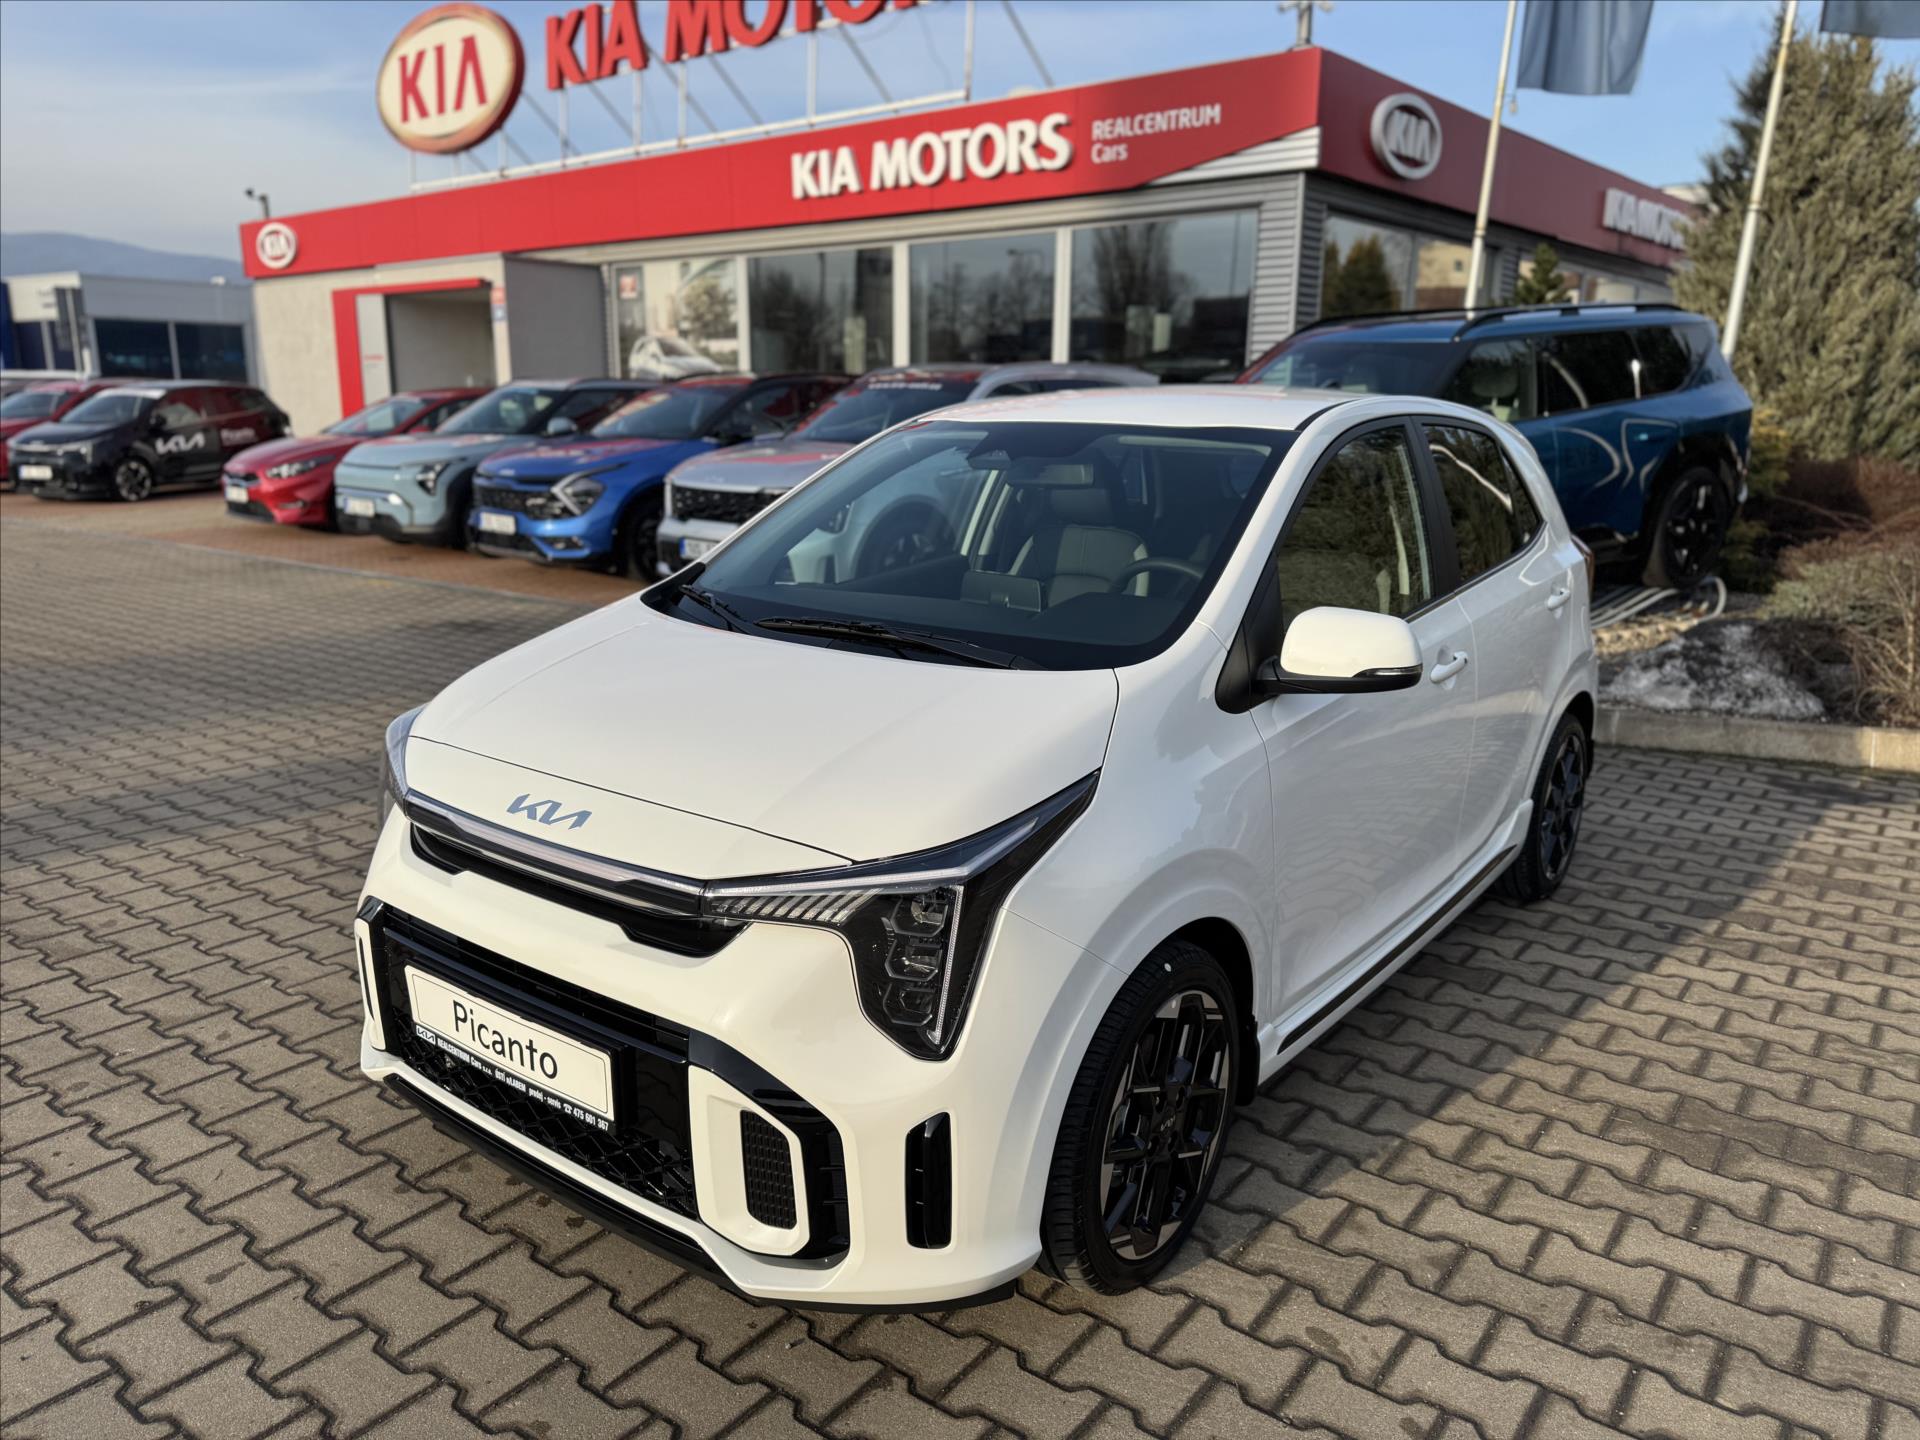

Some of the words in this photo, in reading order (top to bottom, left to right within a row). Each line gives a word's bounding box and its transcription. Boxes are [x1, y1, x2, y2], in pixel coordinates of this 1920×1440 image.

[398, 35, 488, 123] KIA
[545, 0, 649, 91] KIA
[1091, 103, 1222, 141] REALCENTRUM
[1091, 143, 1129, 165] Cars
[1386, 108, 1431, 163] KIA
[791, 146, 862, 200] KIA
[870, 113, 1073, 190] MOTORS
[155, 431, 205, 455] KIA
[506, 793, 592, 830] KIA
[453, 999, 558, 1080] Picanto
[417, 1027, 435, 1043] KIA
[470, 1055, 482, 1070] Cars
[573, 1107, 584, 1120] 475
[585, 1112, 596, 1126] 601
[597, 1118, 609, 1131] 367
